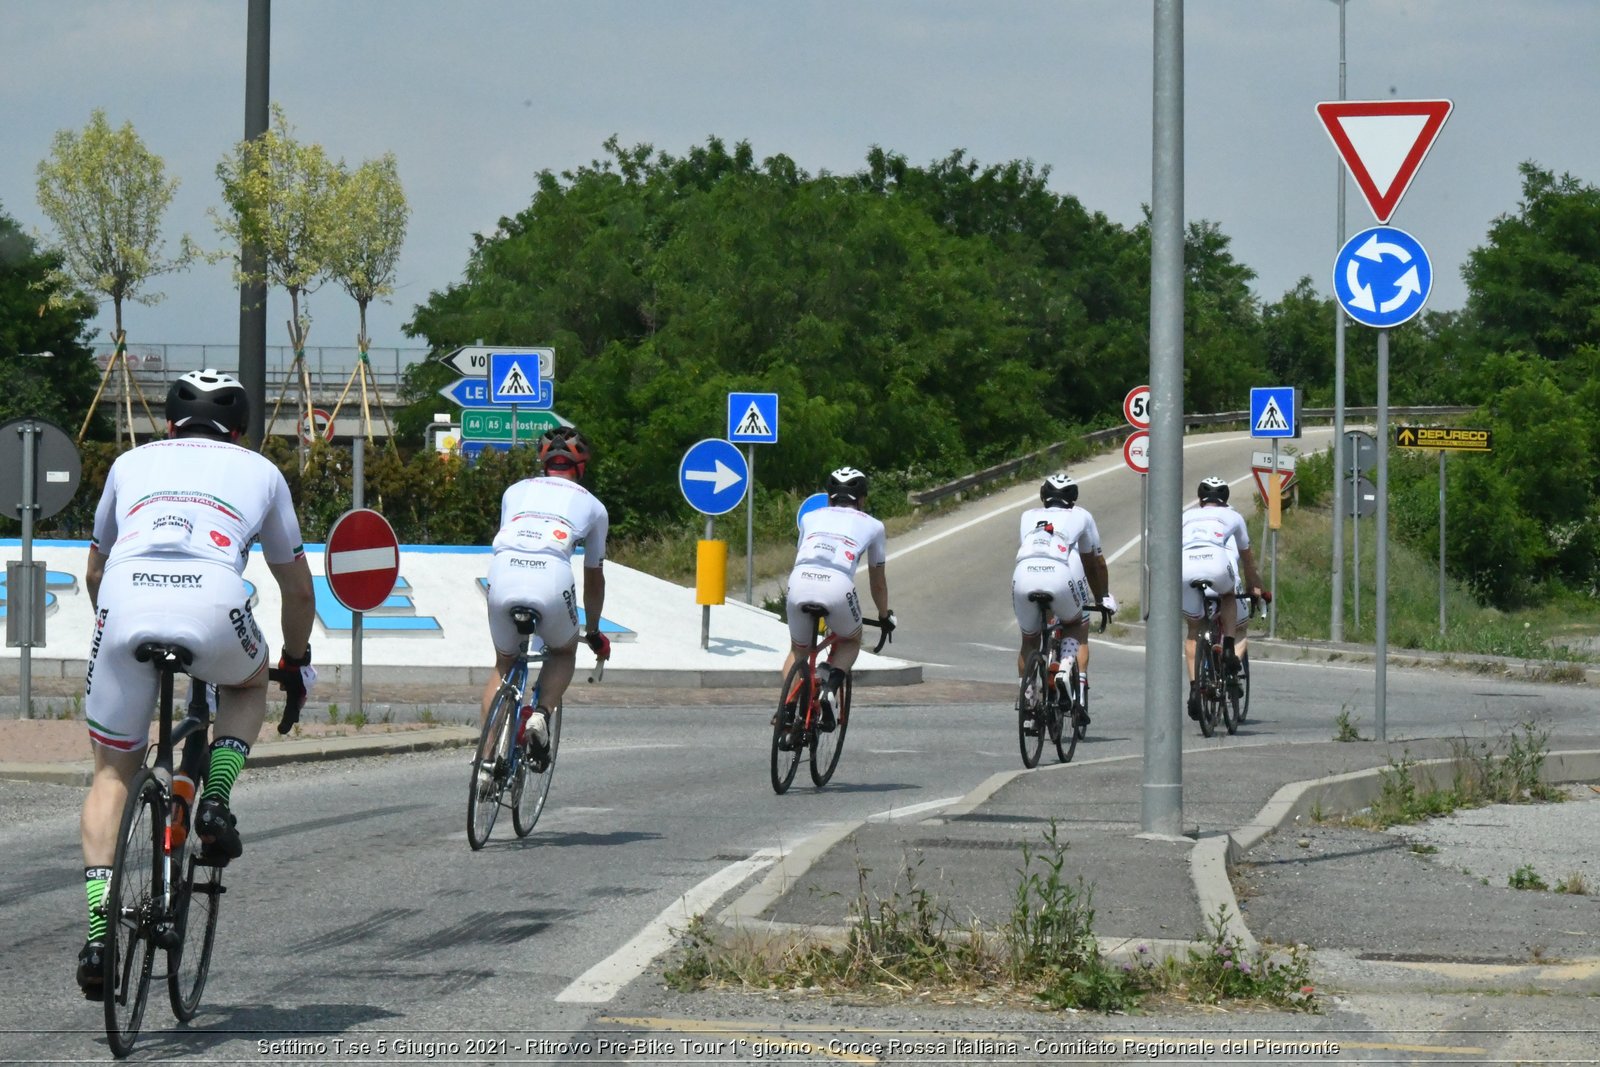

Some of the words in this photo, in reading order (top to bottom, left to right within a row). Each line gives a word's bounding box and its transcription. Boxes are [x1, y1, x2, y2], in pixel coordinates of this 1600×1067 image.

[469, 420, 480, 429] A4
[488, 420, 499, 430] A5
[505, 420, 554, 431] atostrade
[1417, 429, 1488, 441] DEPURECO
[510, 557, 547, 567] FACTORY
[132, 572, 204, 584] FACTORY
[229, 608, 247, 640] che
